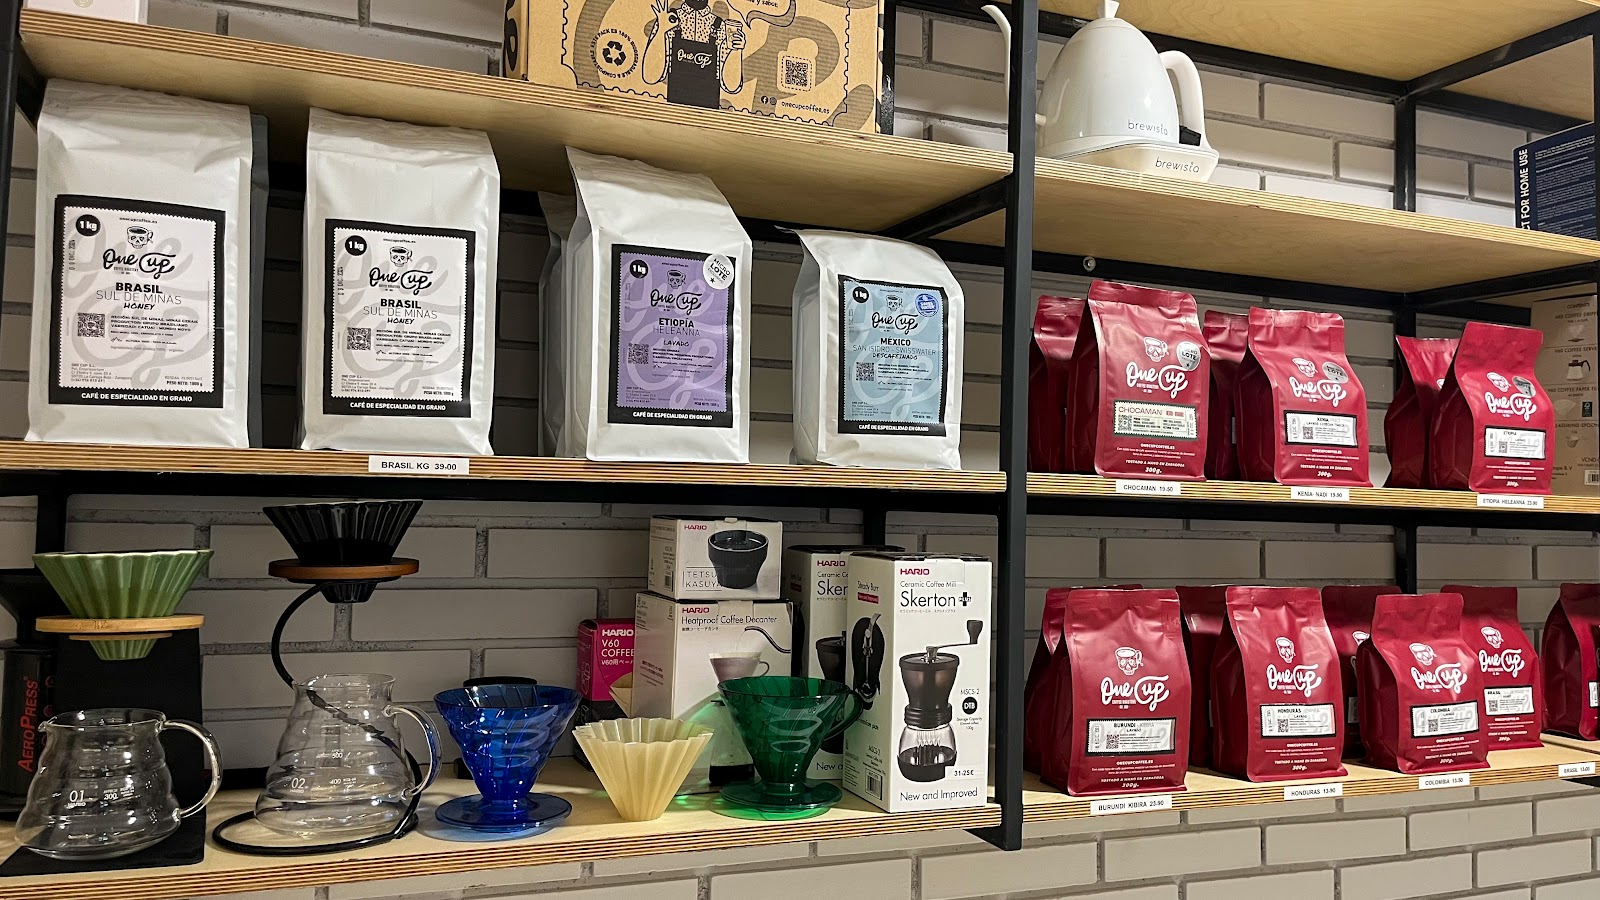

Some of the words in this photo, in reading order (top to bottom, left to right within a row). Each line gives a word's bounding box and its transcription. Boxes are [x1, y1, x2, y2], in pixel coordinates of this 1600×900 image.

[678, 49, 694, 62] One
[694, 52, 712, 68] Cup
[781, 102, 830, 114] onecupcoffee.es
[1128, 120, 1168, 136] brewista
[1156, 156, 1200, 173] brewista
[1518, 148, 1528, 166] USE
[1520, 168, 1530, 198] HOME
[1521, 198, 1530, 220] FOR
[80, 220, 84, 229] 1
[86, 220, 98, 232] kg
[354, 242, 364, 251] kg
[104, 248, 138, 270] One
[139, 252, 176, 280] Cup
[639, 265, 646, 275] kg
[712, 258, 730, 276] MICRO
[710, 263, 728, 281] LOTE
[116, 282, 164, 294] BRASIL
[369, 267, 400, 287] One
[401, 270, 433, 295] Cup
[97, 290, 118, 302] SUL
[124, 292, 138, 302] DE
[142, 293, 182, 305] MINAS
[650, 289, 675, 307] One
[676, 292, 702, 315] Cup
[860, 291, 867, 299] kg
[124, 302, 156, 310] HONEY
[380, 299, 422, 309] BRASIL
[363, 306, 383, 315] SUL
[388, 307, 401, 317] DE
[405, 308, 438, 319] MINAS
[658, 317, 694, 328] ETIOPÍA
[872, 312, 894, 328] One
[895, 314, 919, 334] Cup
[653, 325, 700, 337] HELEANNA
[880, 336, 910, 346] MÉXICO
[868, 345, 890, 353] ISIDRO
[896, 347, 936, 356] SWISSWATER
[1126, 361, 1158, 387] One
[1158, 364, 1188, 399] Cup
[1289, 376, 1317, 397] One
[1316, 380, 1346, 407] Cup
[1118, 406, 1162, 416] CHOCAMAN
[1484, 392, 1510, 413] One
[1510, 393, 1537, 421] Cup
[817, 580, 848, 596] Sker
[900, 588, 956, 607] Skerton
[682, 615, 718, 626] Heatproof
[721, 615, 746, 624] Coffee
[602, 639, 619, 648] V60
[601, 648, 634, 657] COFFEE
[1478, 649, 1501, 672] One
[1500, 649, 1524, 678] Cup
[1266, 664, 1293, 690] One
[1293, 664, 1322, 698] Cup
[1410, 667, 1436, 690] One
[1435, 663, 1468, 694] Cup
[1100, 676, 1134, 705] One
[1134, 675, 1170, 711] Cup
[816, 762, 835, 770] New
[292, 778, 305, 789] 02
[70, 790, 85, 802] 01
[900, 792, 921, 801] New
[922, 790, 938, 800] and
[940, 787, 978, 799] Improved
